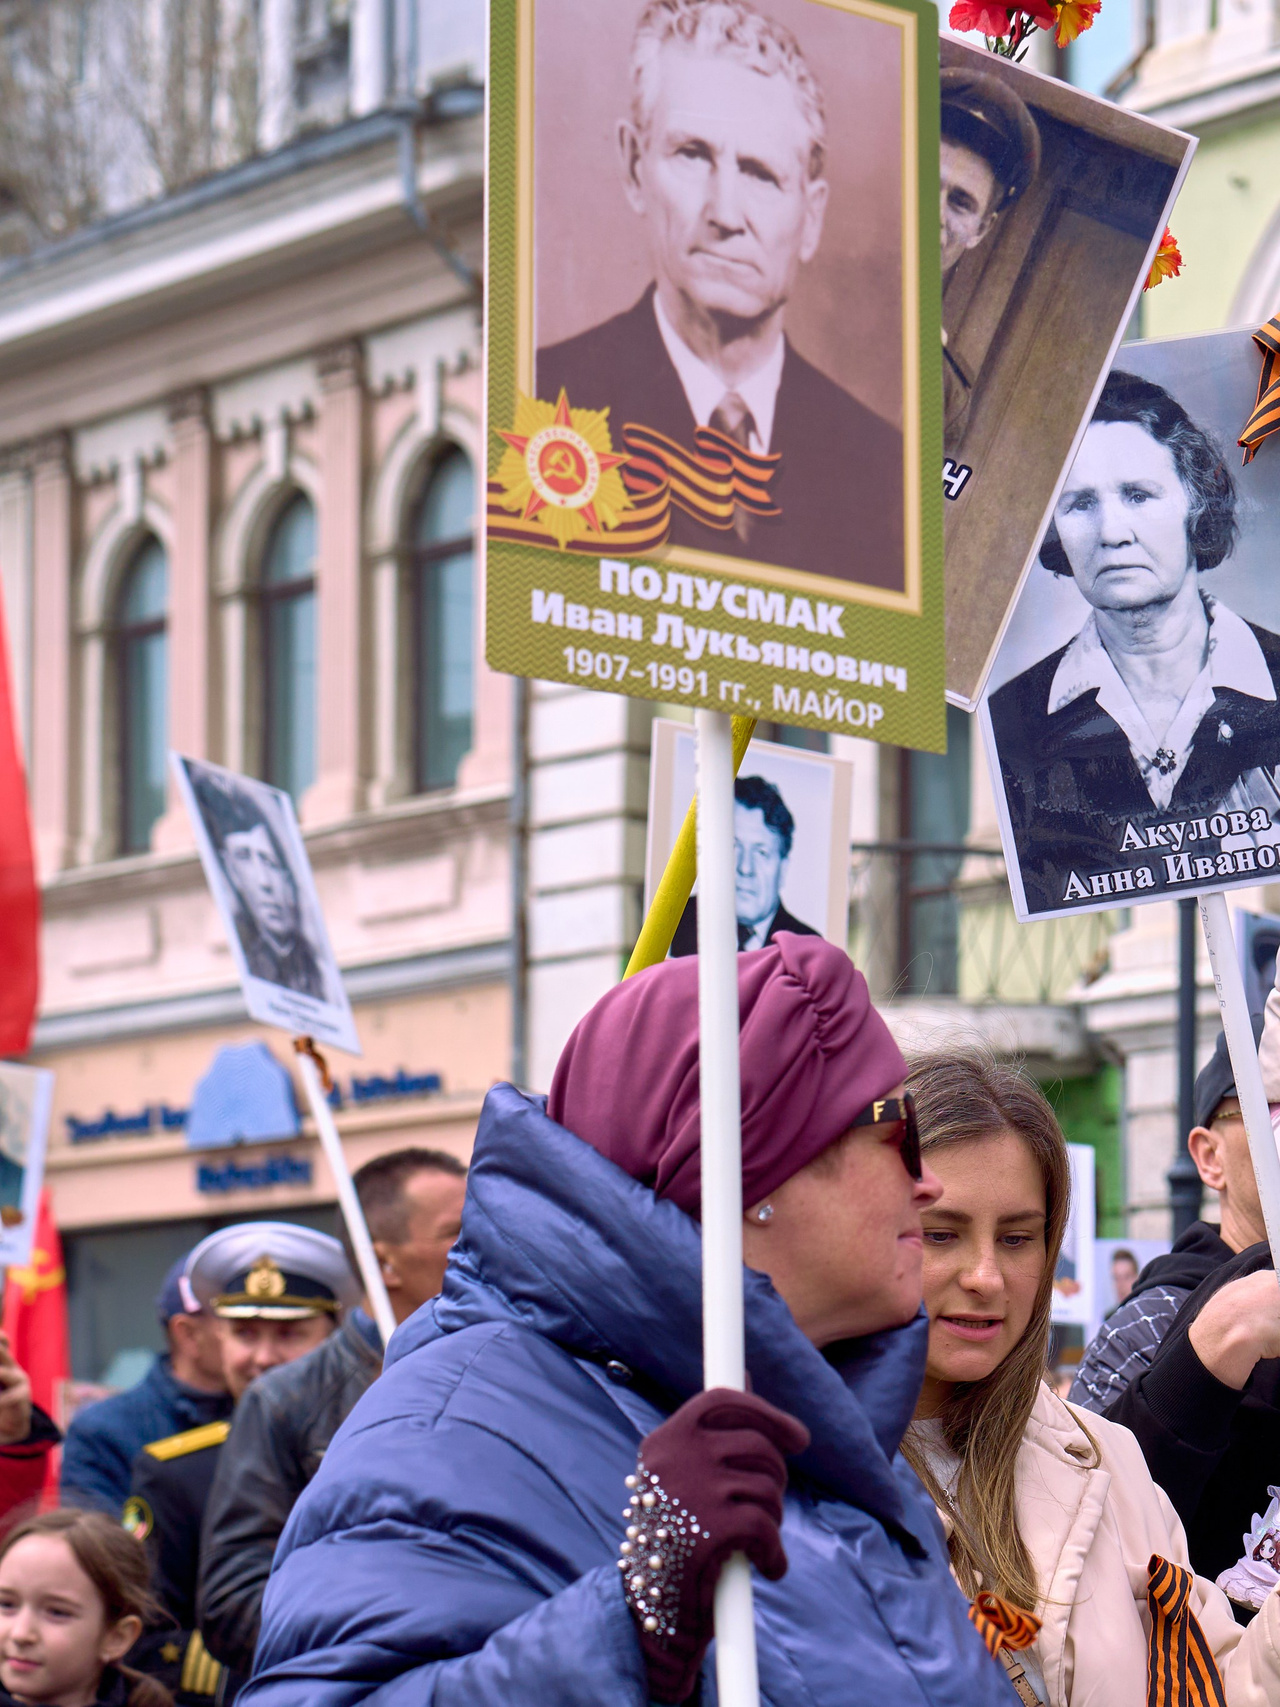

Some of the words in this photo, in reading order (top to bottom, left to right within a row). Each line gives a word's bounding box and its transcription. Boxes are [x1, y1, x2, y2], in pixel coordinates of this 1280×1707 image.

[599, 558, 846, 639] ПОЛУСМАК
[531, 589, 643, 641] Иван
[652, 611, 908, 692] Лукьянович
[562, 646, 708, 697] 1907-1991
[719, 680, 762, 710] гг.,
[772, 683, 884, 728] МАЙОР
[1119, 806, 1271, 852] Акулова
[1062, 867, 1156, 901] Анна
